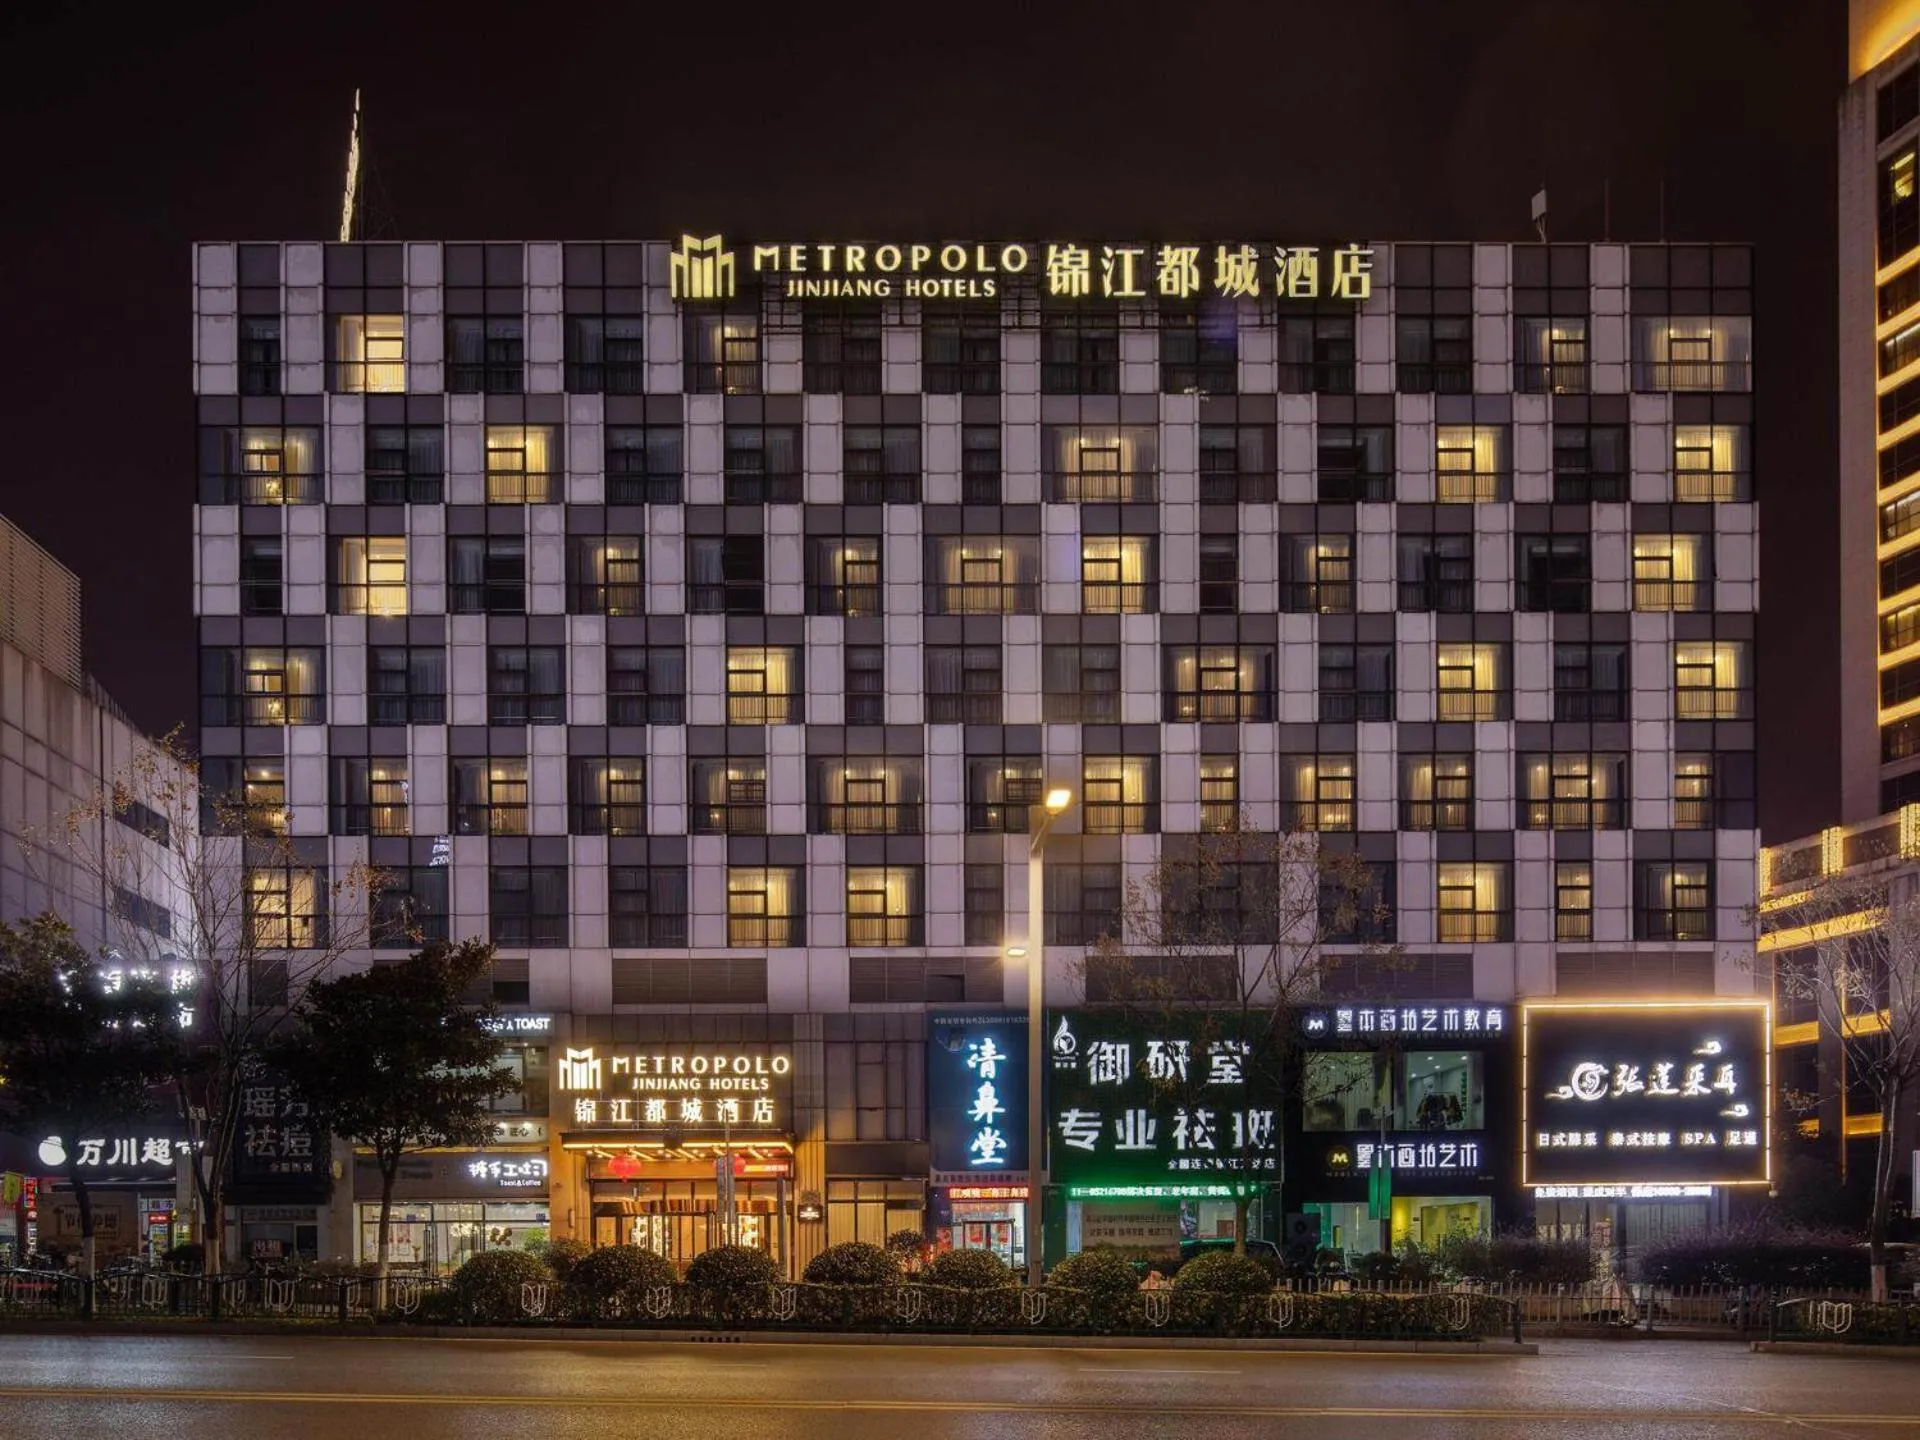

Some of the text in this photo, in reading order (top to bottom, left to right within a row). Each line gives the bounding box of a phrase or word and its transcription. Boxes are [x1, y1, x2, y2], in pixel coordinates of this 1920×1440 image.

[753, 245, 1028, 272] METROPOLO
[1046, 243, 1375, 299] 锦江都城酒店
[786, 279, 996, 298] JINJIANG HOTELS
[612, 1056, 790, 1074] METROPOLO
[632, 1078, 769, 1090] JINJIANG HOTELS
[574, 1097, 774, 1124] 锦江都城酒店
[1683, 1132, 1717, 1146] SPA
